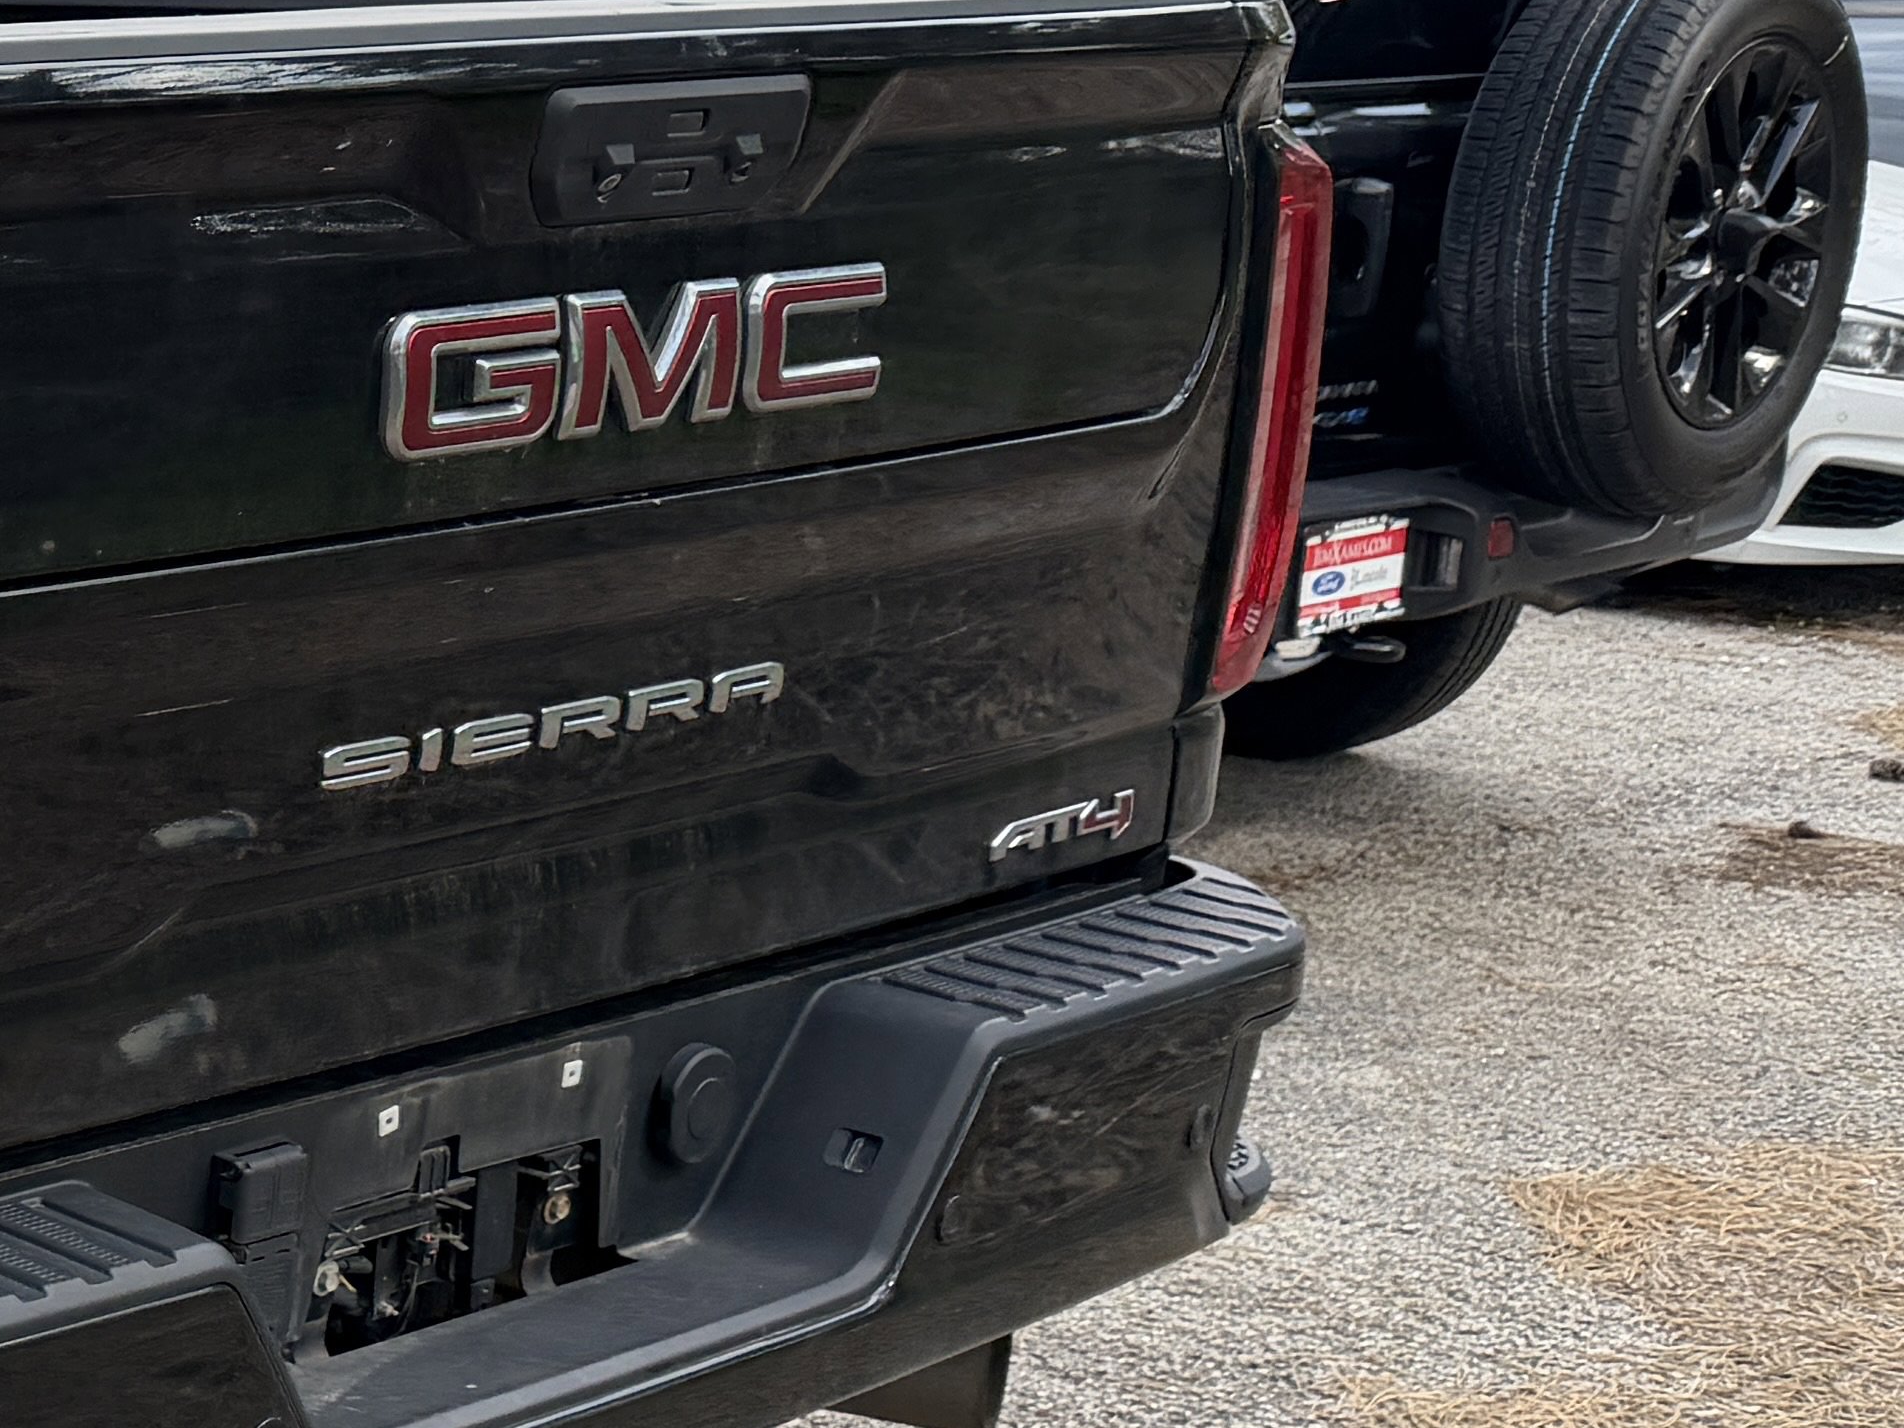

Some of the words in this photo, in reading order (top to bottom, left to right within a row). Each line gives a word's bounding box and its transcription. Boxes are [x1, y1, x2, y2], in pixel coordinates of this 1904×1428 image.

[382, 262, 888, 461] GMC
[319, 661, 785, 791] SIERRA
[988, 788, 1135, 863] AT4
